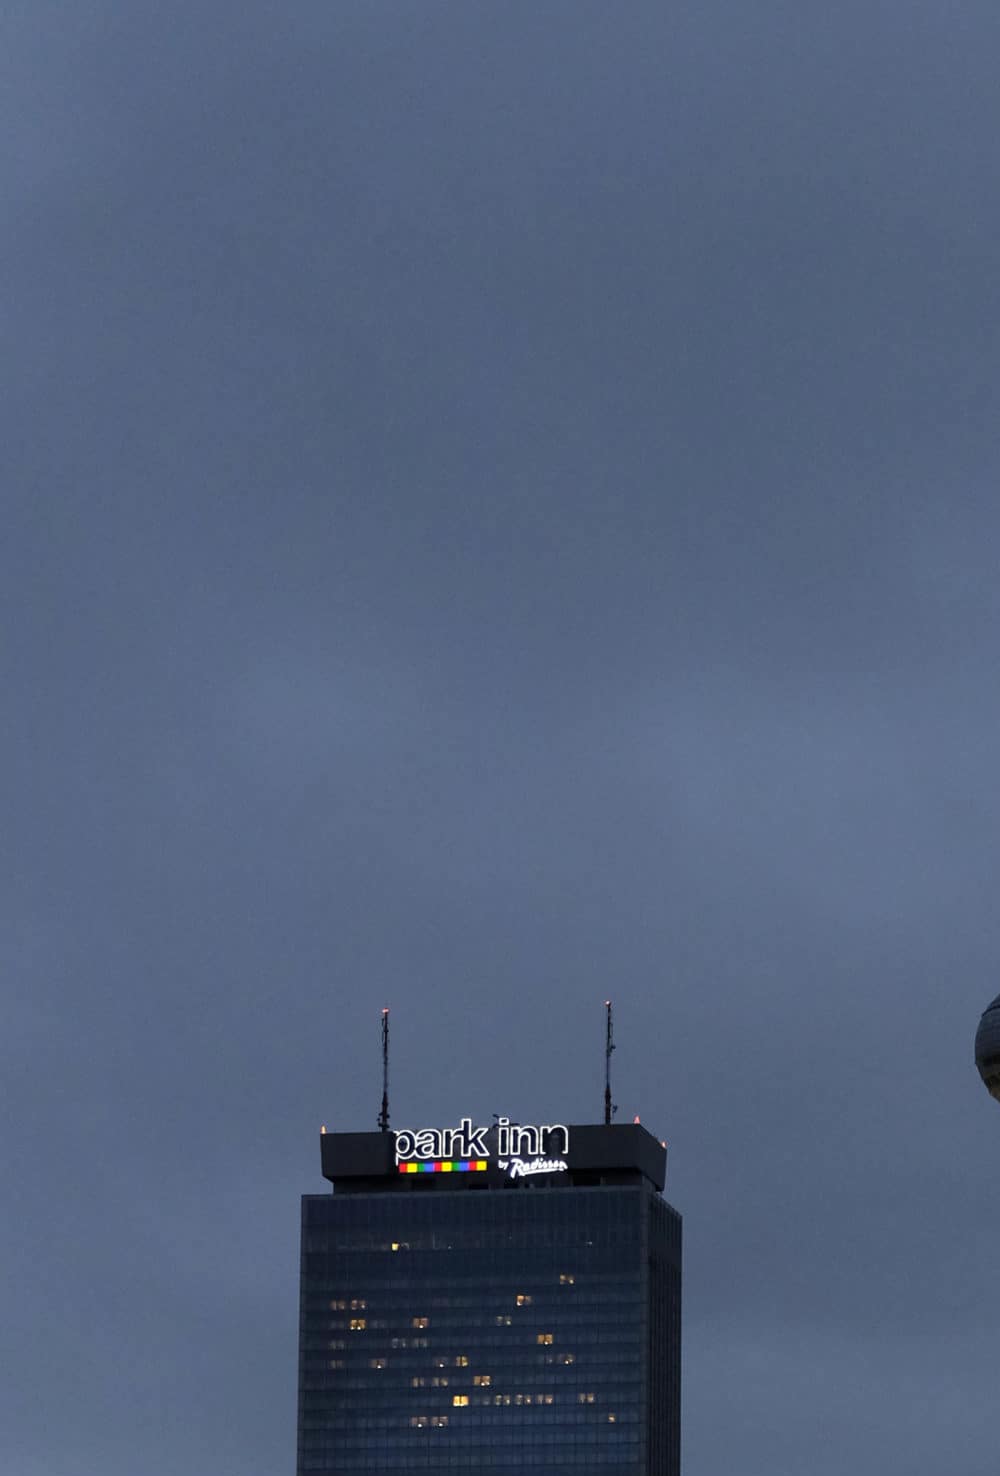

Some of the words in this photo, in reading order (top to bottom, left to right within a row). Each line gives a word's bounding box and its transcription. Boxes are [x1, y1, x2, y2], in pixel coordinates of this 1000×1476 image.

[394, 1118, 490, 1167] park
[498, 1117, 569, 1156] inn
[498, 1159, 509, 1170] by
[510, 1157, 569, 1179] Radisson
